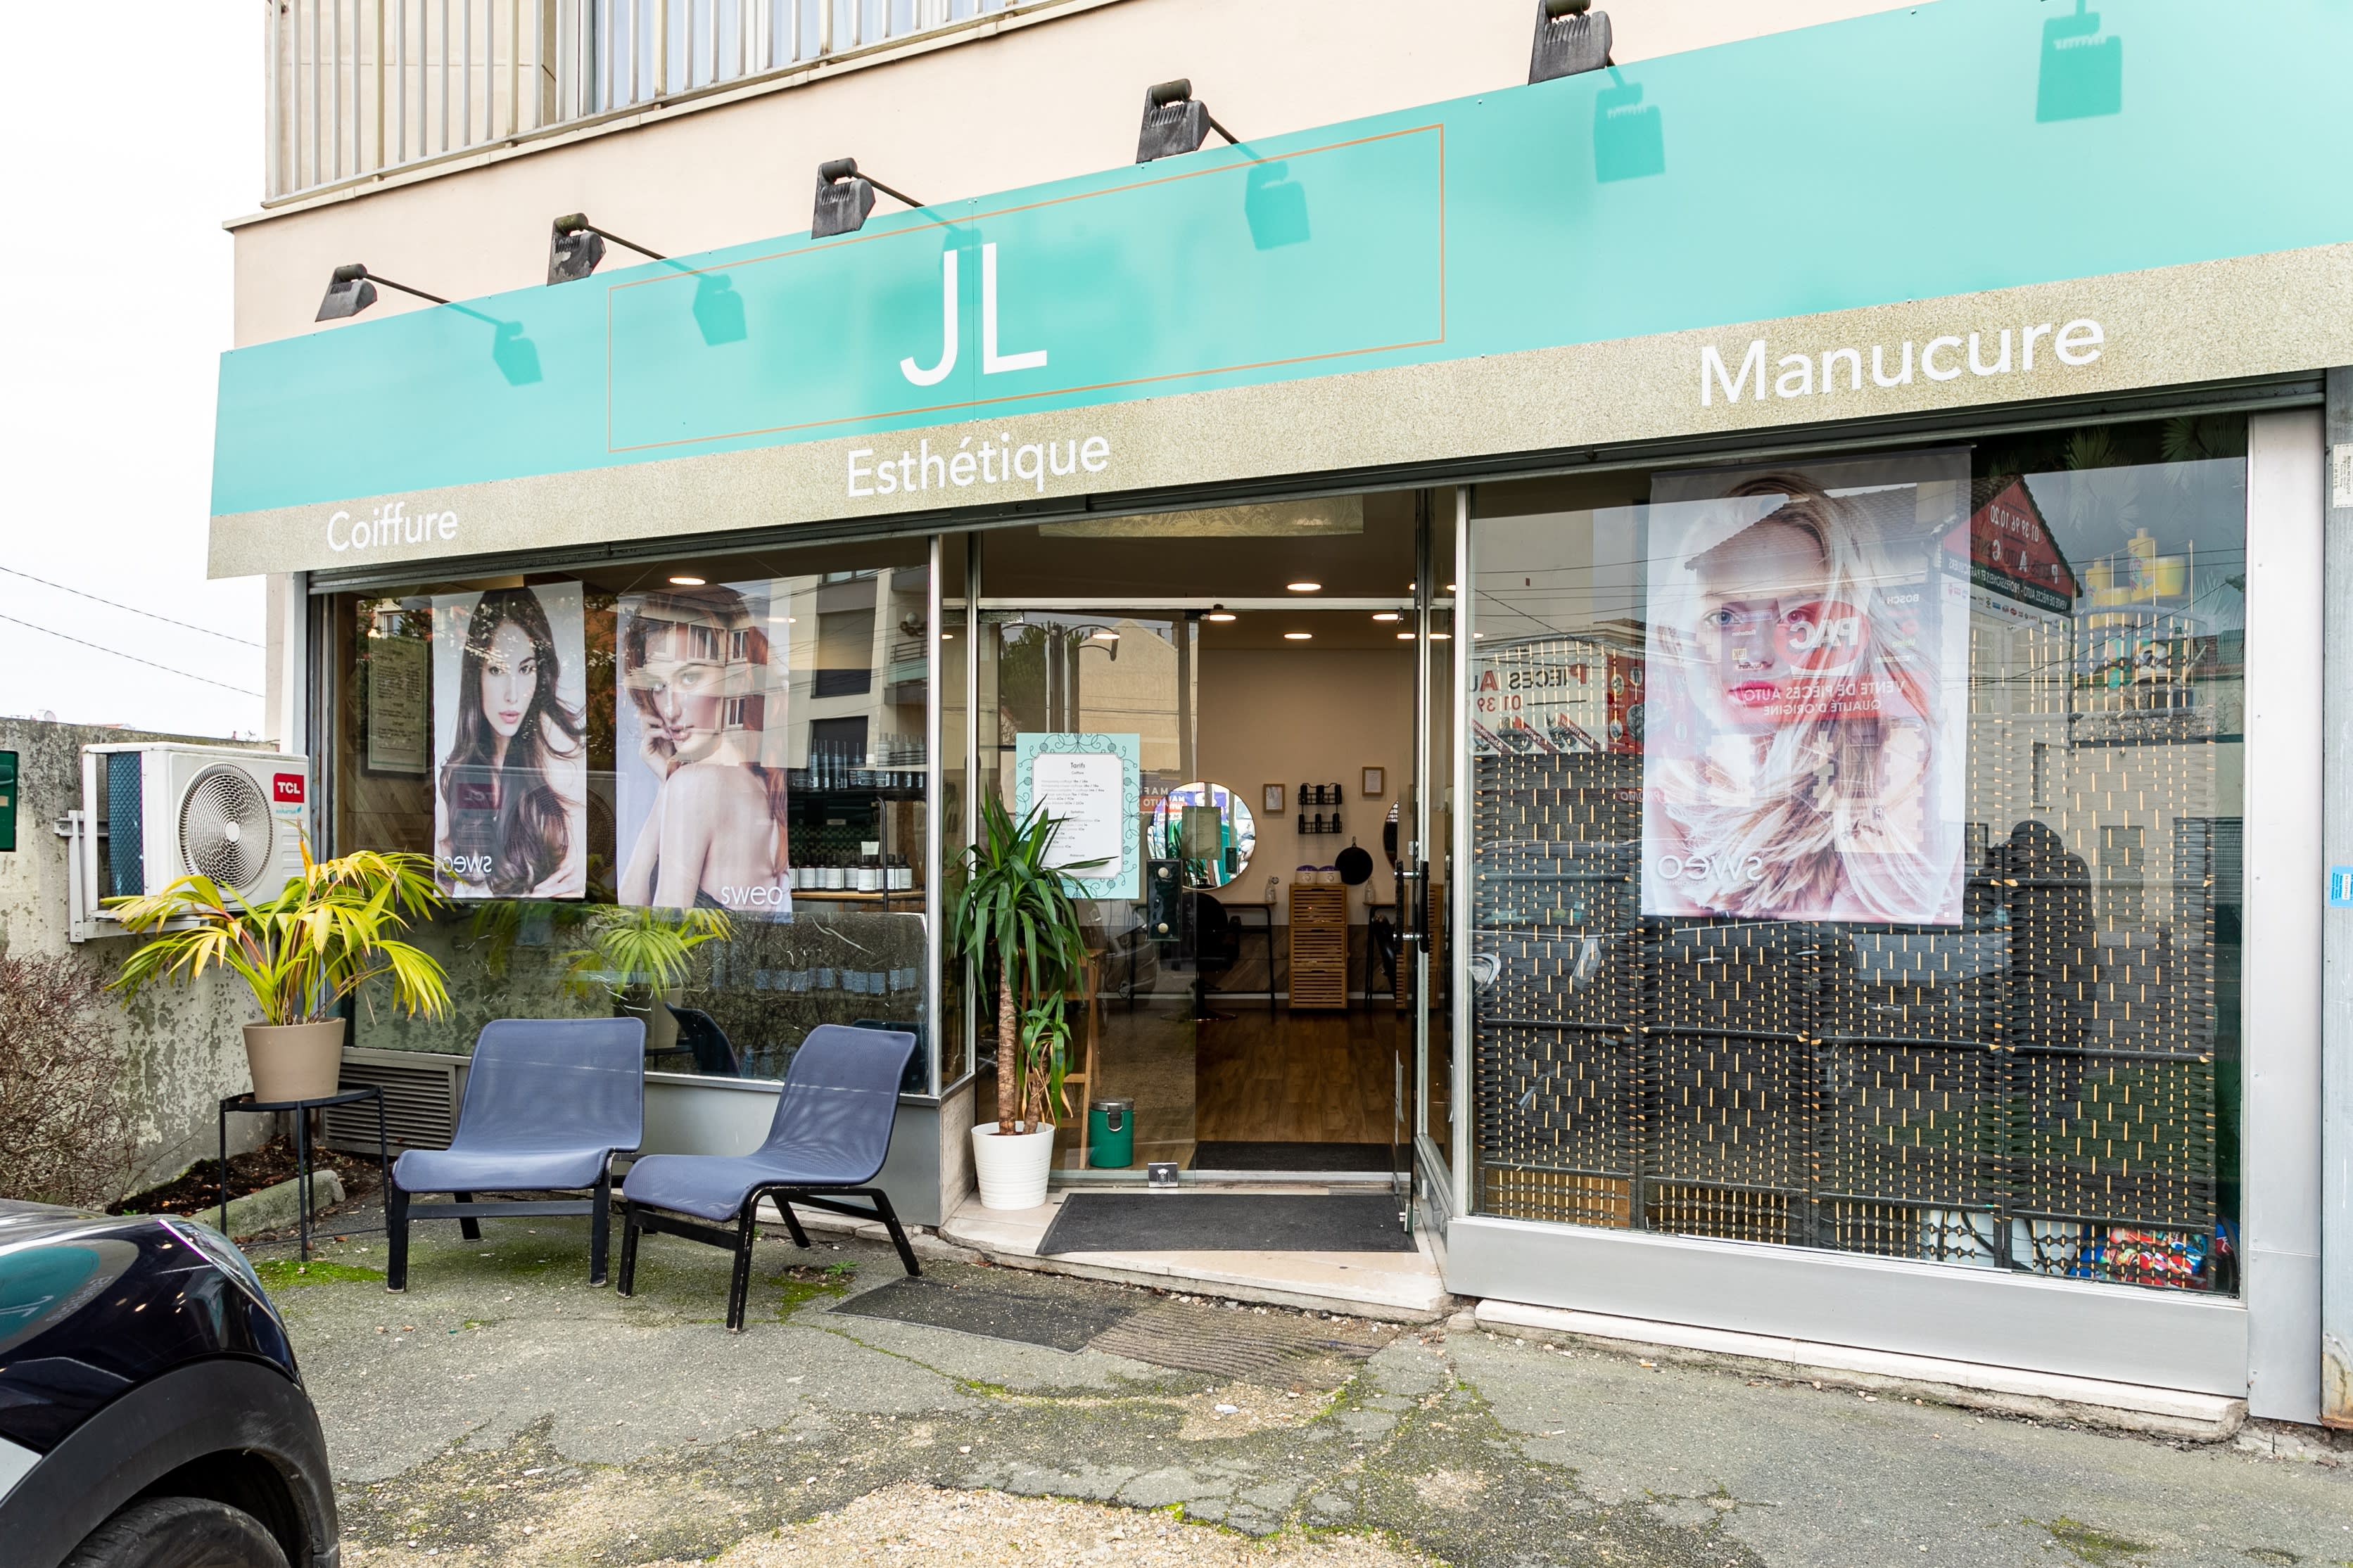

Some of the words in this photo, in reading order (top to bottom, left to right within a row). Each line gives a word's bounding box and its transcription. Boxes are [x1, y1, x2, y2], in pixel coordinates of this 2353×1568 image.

[900, 243, 1047, 386] JL
[1701, 319, 2105, 407] Manucure
[848, 433, 1110, 497] Esthétique
[326, 502, 458, 552] Coiffure
[277, 782, 300, 794] TCL
[721, 886, 782, 905] sweo
